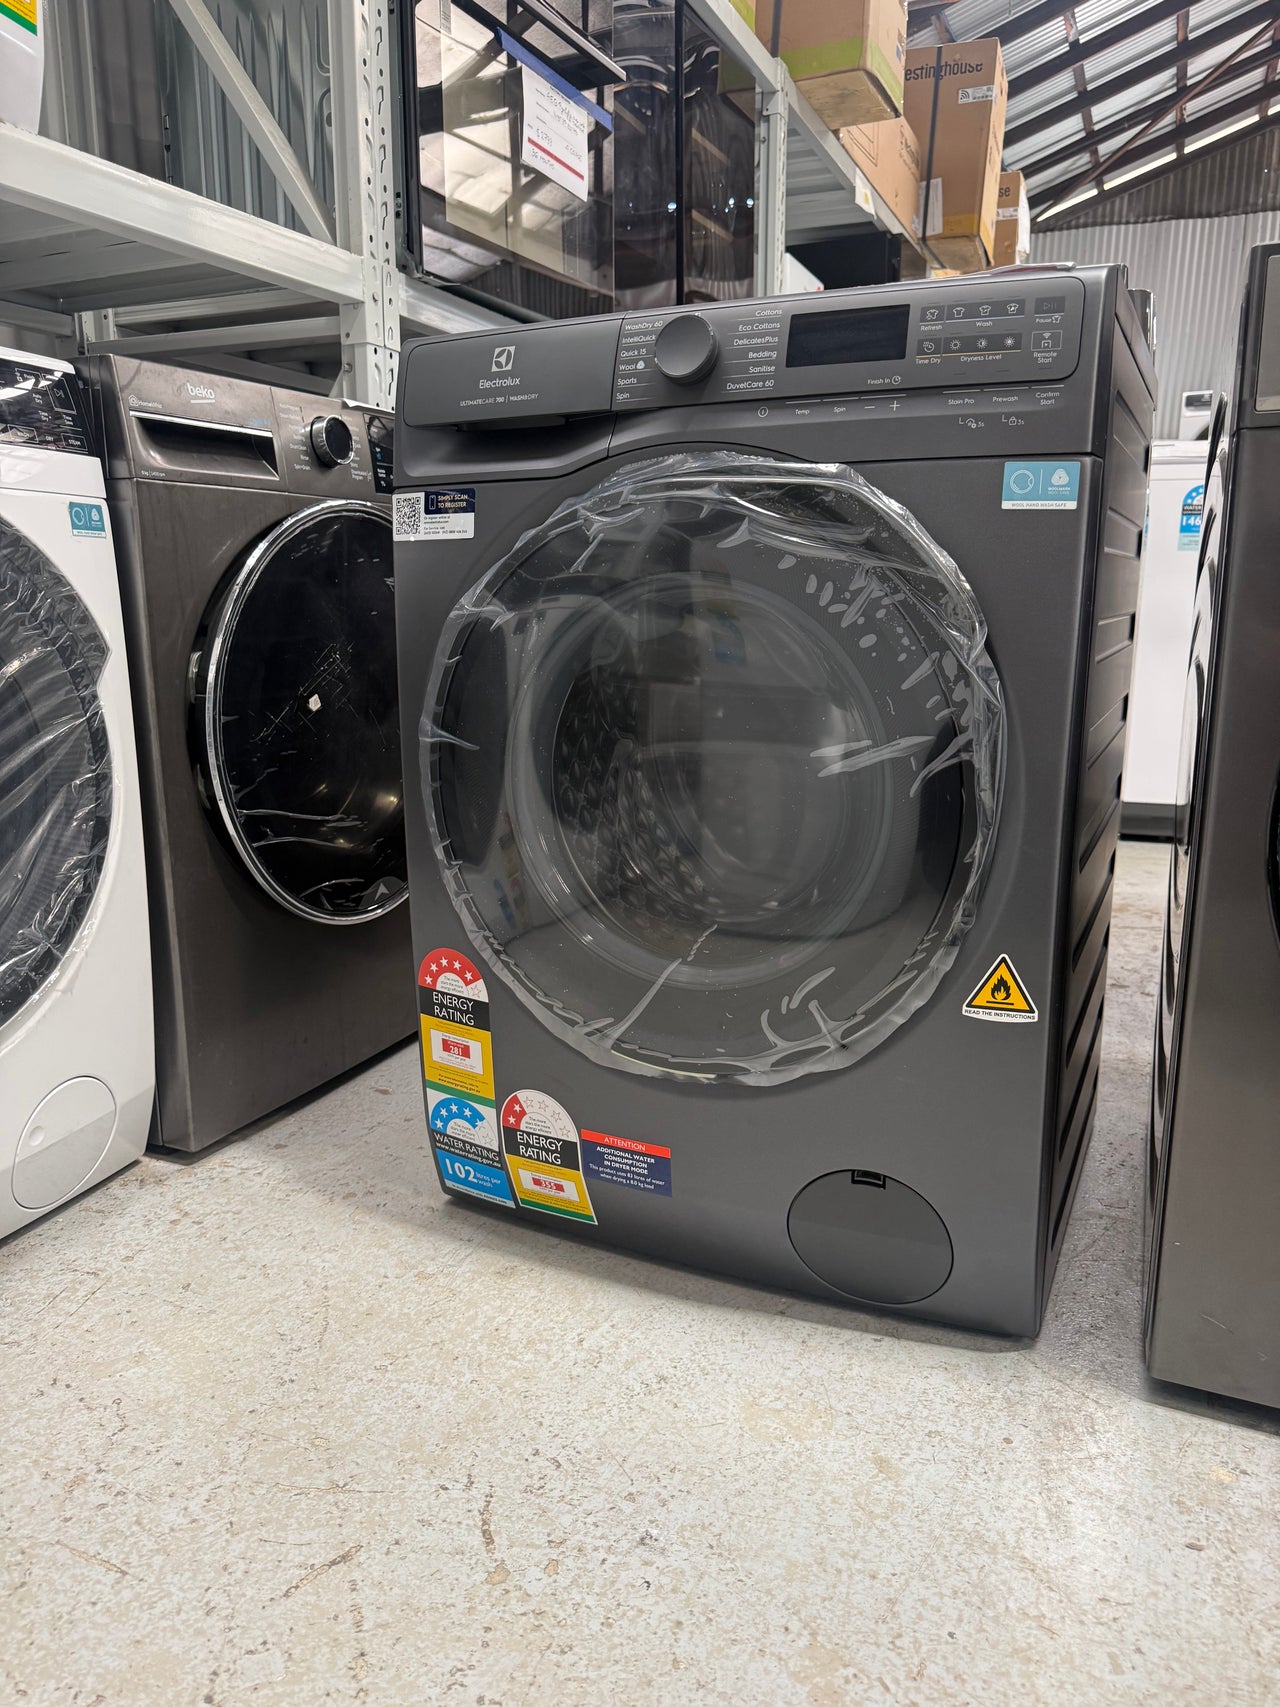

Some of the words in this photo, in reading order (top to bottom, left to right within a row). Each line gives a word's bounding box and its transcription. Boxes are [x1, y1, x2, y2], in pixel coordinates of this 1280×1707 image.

[905, 60, 983, 80] estinghouse
[755, 309, 782, 317] Cottons
[625, 322, 653, 330] WashDry
[738, 324, 751, 332] Eco
[753, 322, 780, 330] Cottons
[622, 334, 656, 344] IntelliQuick
[733, 336, 779, 346] DelicatesPlus
[620, 350, 638, 358] Quick
[748, 350, 777, 359] Bedding
[960, 355, 985, 363] Dryness
[930, 357, 941, 365] Dry
[619, 363, 635, 371] Wool
[748, 365, 776, 373] Sanitise
[479, 376, 521, 389] Electrolux
[617, 377, 637, 386] Sports
[726, 381, 763, 390] DuvetCare
[764, 379, 774, 387] 60
[186, 382, 215, 399] beko
[616, 392, 630, 400] Spin
[992, 395, 1019, 403] Prewash
[460, 397, 495, 406] ULTIMATECARE
[433, 991, 474, 1012] ENERGY
[434, 1005, 475, 1026] RATING
[993, 1011, 1036, 1020] INSTRUCTIONS
[449, 1045, 462, 1056] 281
[538, 1127, 552, 1135] efficient
[433, 1132, 465, 1151] WATER
[465, 1143, 499, 1161] RATING
[517, 1131, 563, 1152] ENERGY
[604, 1136, 646, 1151] ATTENTION
[435, 1142, 502, 1168] www.waterrating.gov.au
[519, 1145, 561, 1165] RATING
[596, 1146, 633, 1159] ADDITIONAL
[633, 1154, 655, 1164] WATER
[604, 1154, 648, 1169] CONSUMPTION
[445, 1158, 477, 1183] 102
[599, 1166, 616, 1175] product
[611, 1162, 630, 1171] DRYER
[631, 1167, 649, 1175] MODE
[475, 1171, 490, 1181] litres
[490, 1177, 501, 1185] per
[612, 1175, 627, 1184] drying
[644, 1182, 654, 1190] load
[476, 1179, 493, 1188] wash
[540, 1180, 557, 1190] 355
